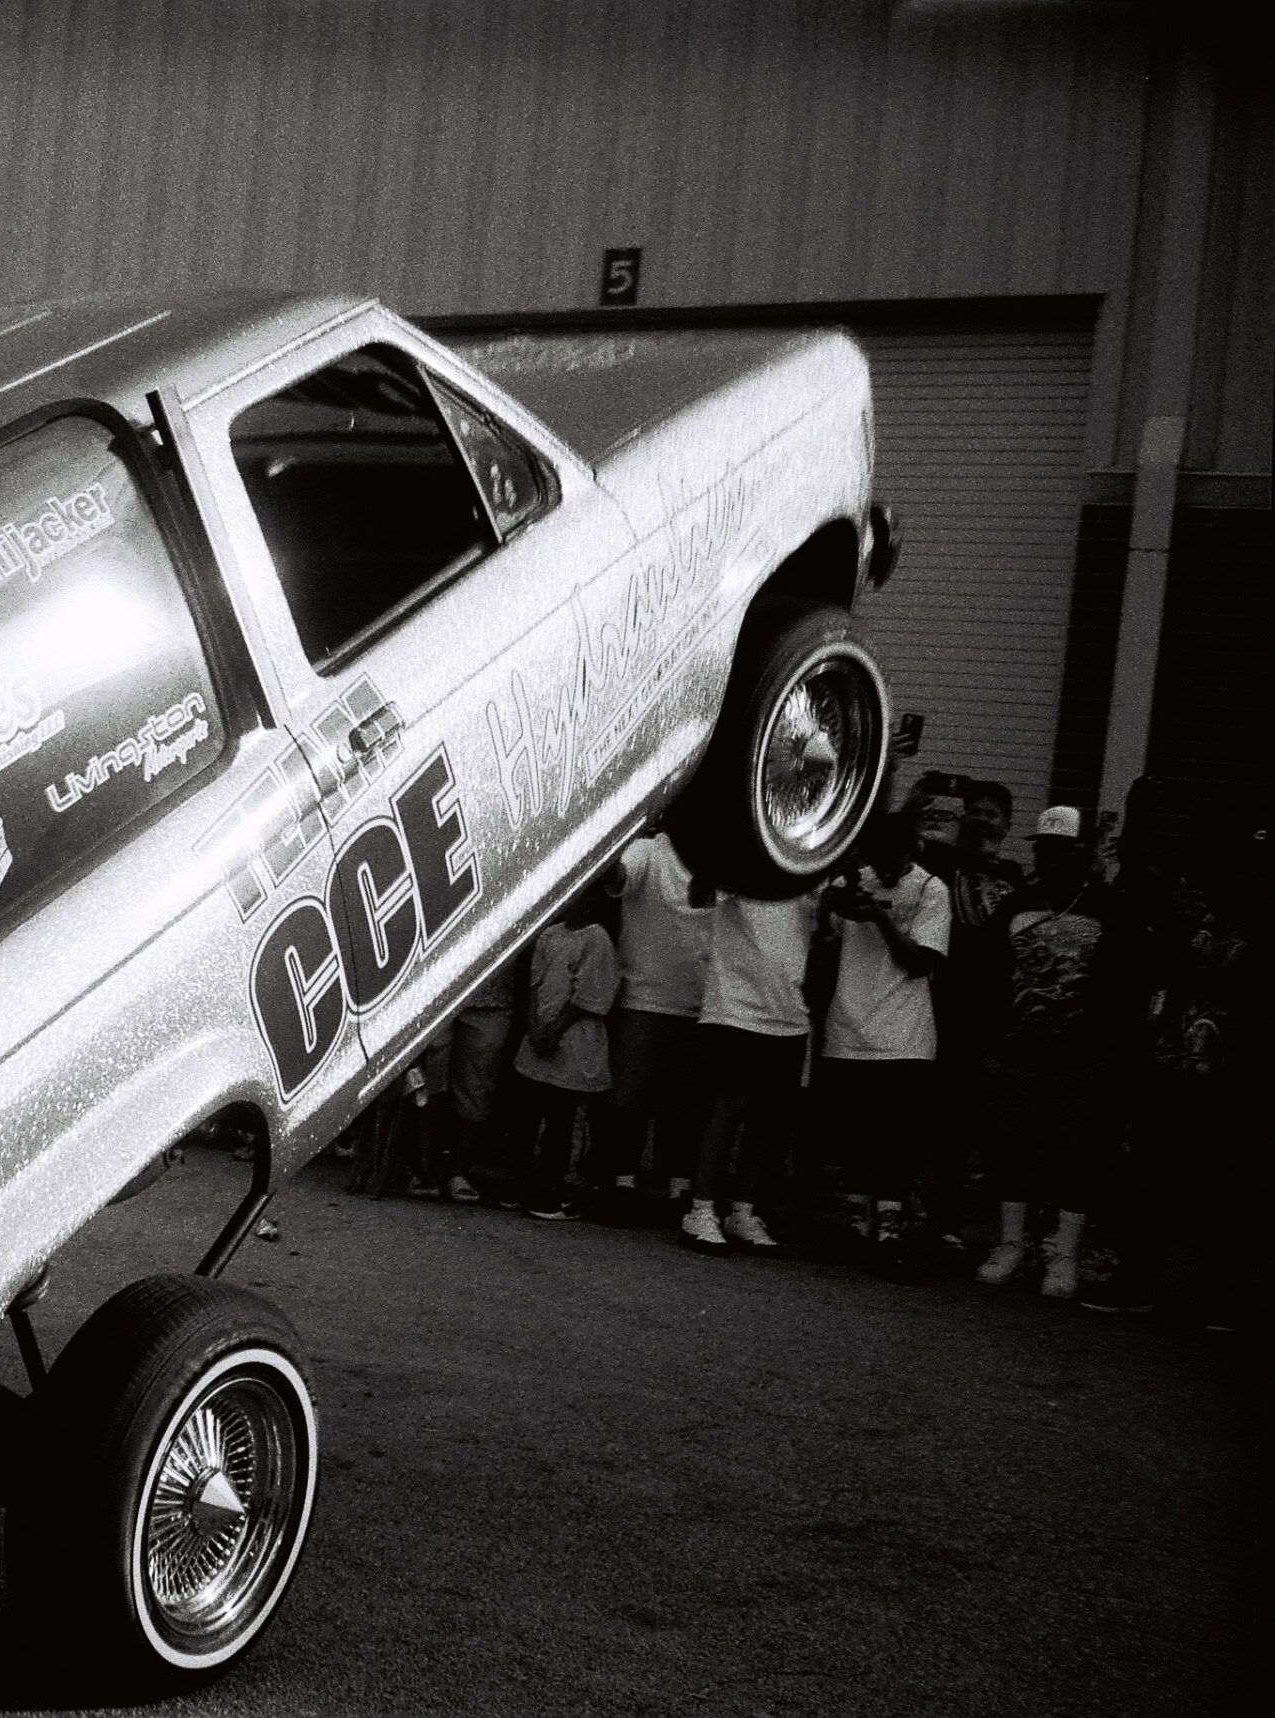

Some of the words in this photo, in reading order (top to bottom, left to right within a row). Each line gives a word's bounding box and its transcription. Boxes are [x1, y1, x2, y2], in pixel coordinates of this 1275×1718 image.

[607, 260, 633, 294] 5
[45, 692, 206, 812] Livingston
[592, 733, 611, 763] THE
[612, 700, 639, 737] NEXT
[640, 622, 700, 701] GENERATION
[192, 672, 405, 924] TEAM
[249, 741, 483, 1105] CCE
